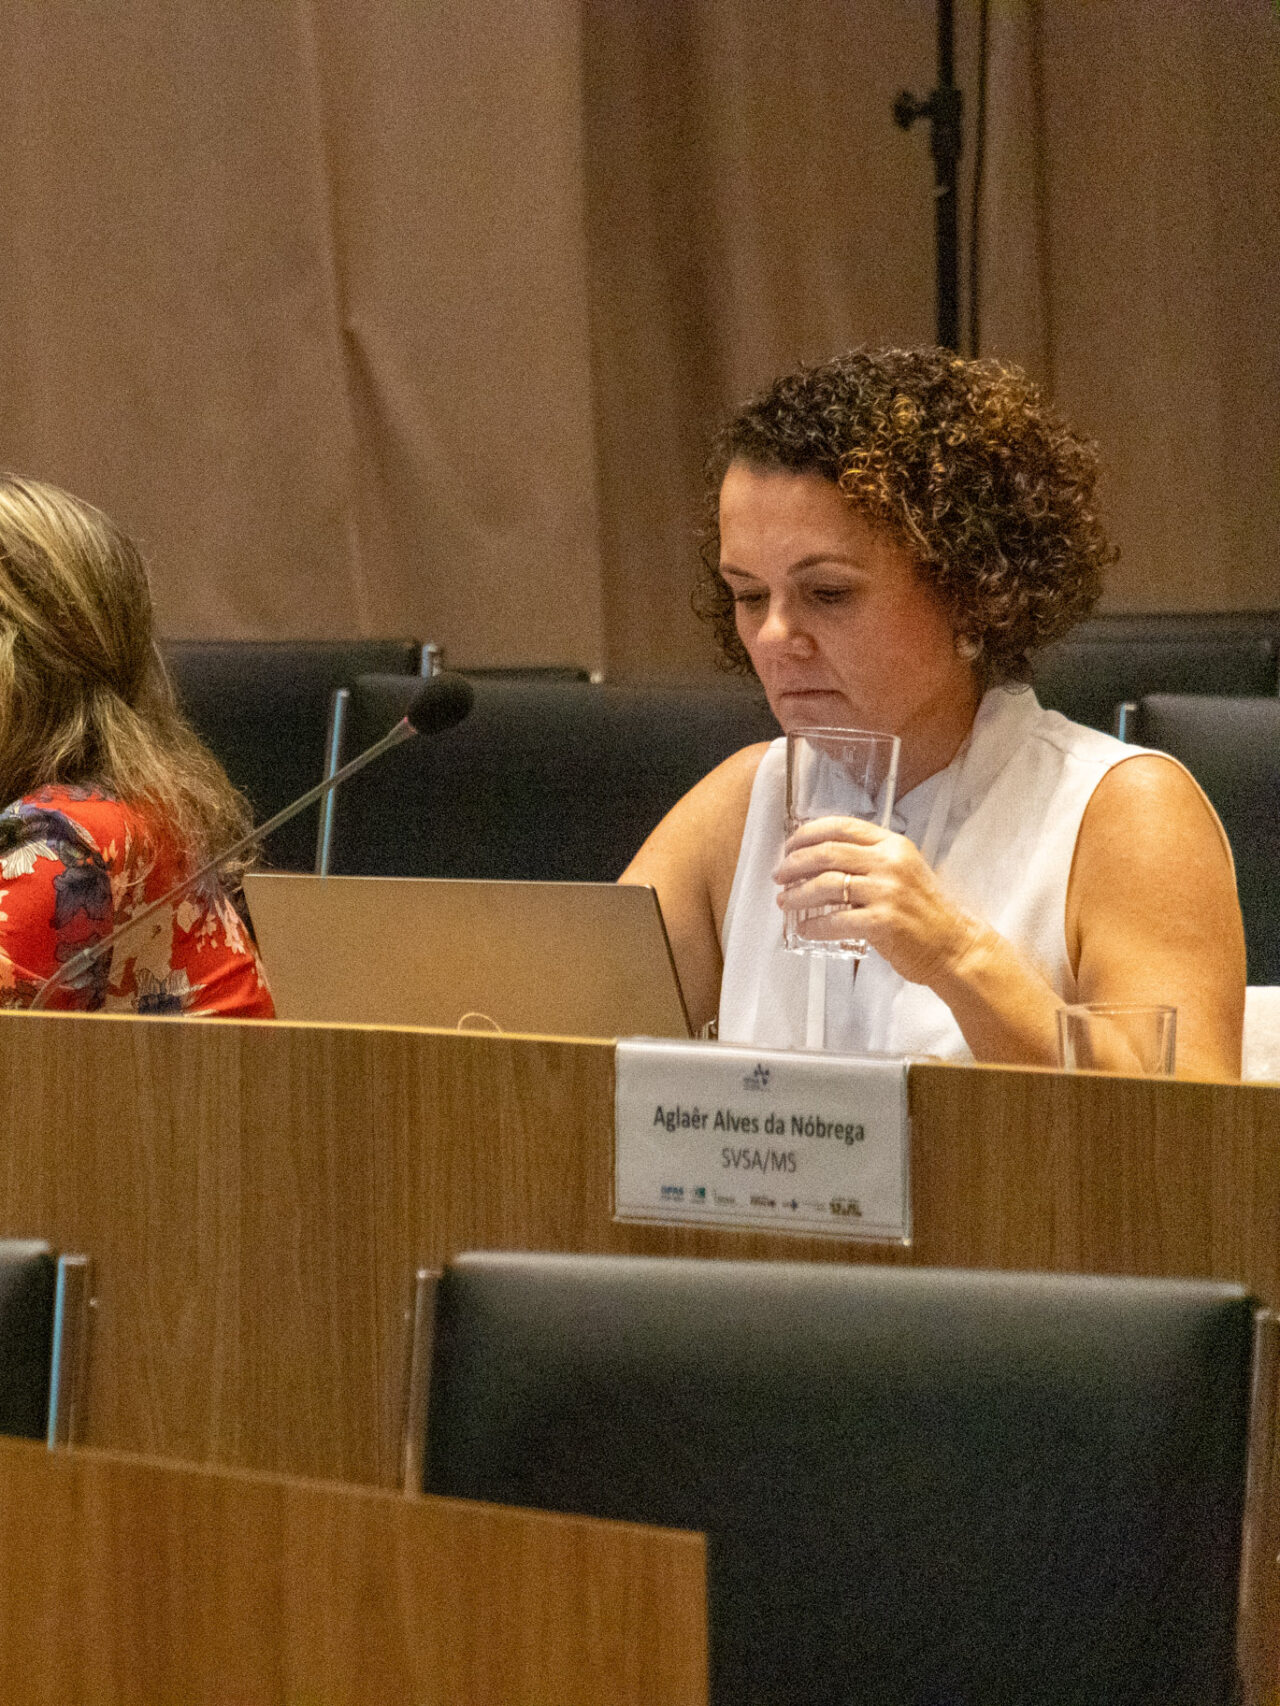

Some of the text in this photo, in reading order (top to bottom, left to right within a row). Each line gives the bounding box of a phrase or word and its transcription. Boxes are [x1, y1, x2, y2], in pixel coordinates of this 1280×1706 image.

[714, 1109, 759, 1134] Alves
[764, 1112, 785, 1135] da
[791, 1115, 865, 1145] Nóbrega
[722, 1148, 797, 1173] SVSA/MS
